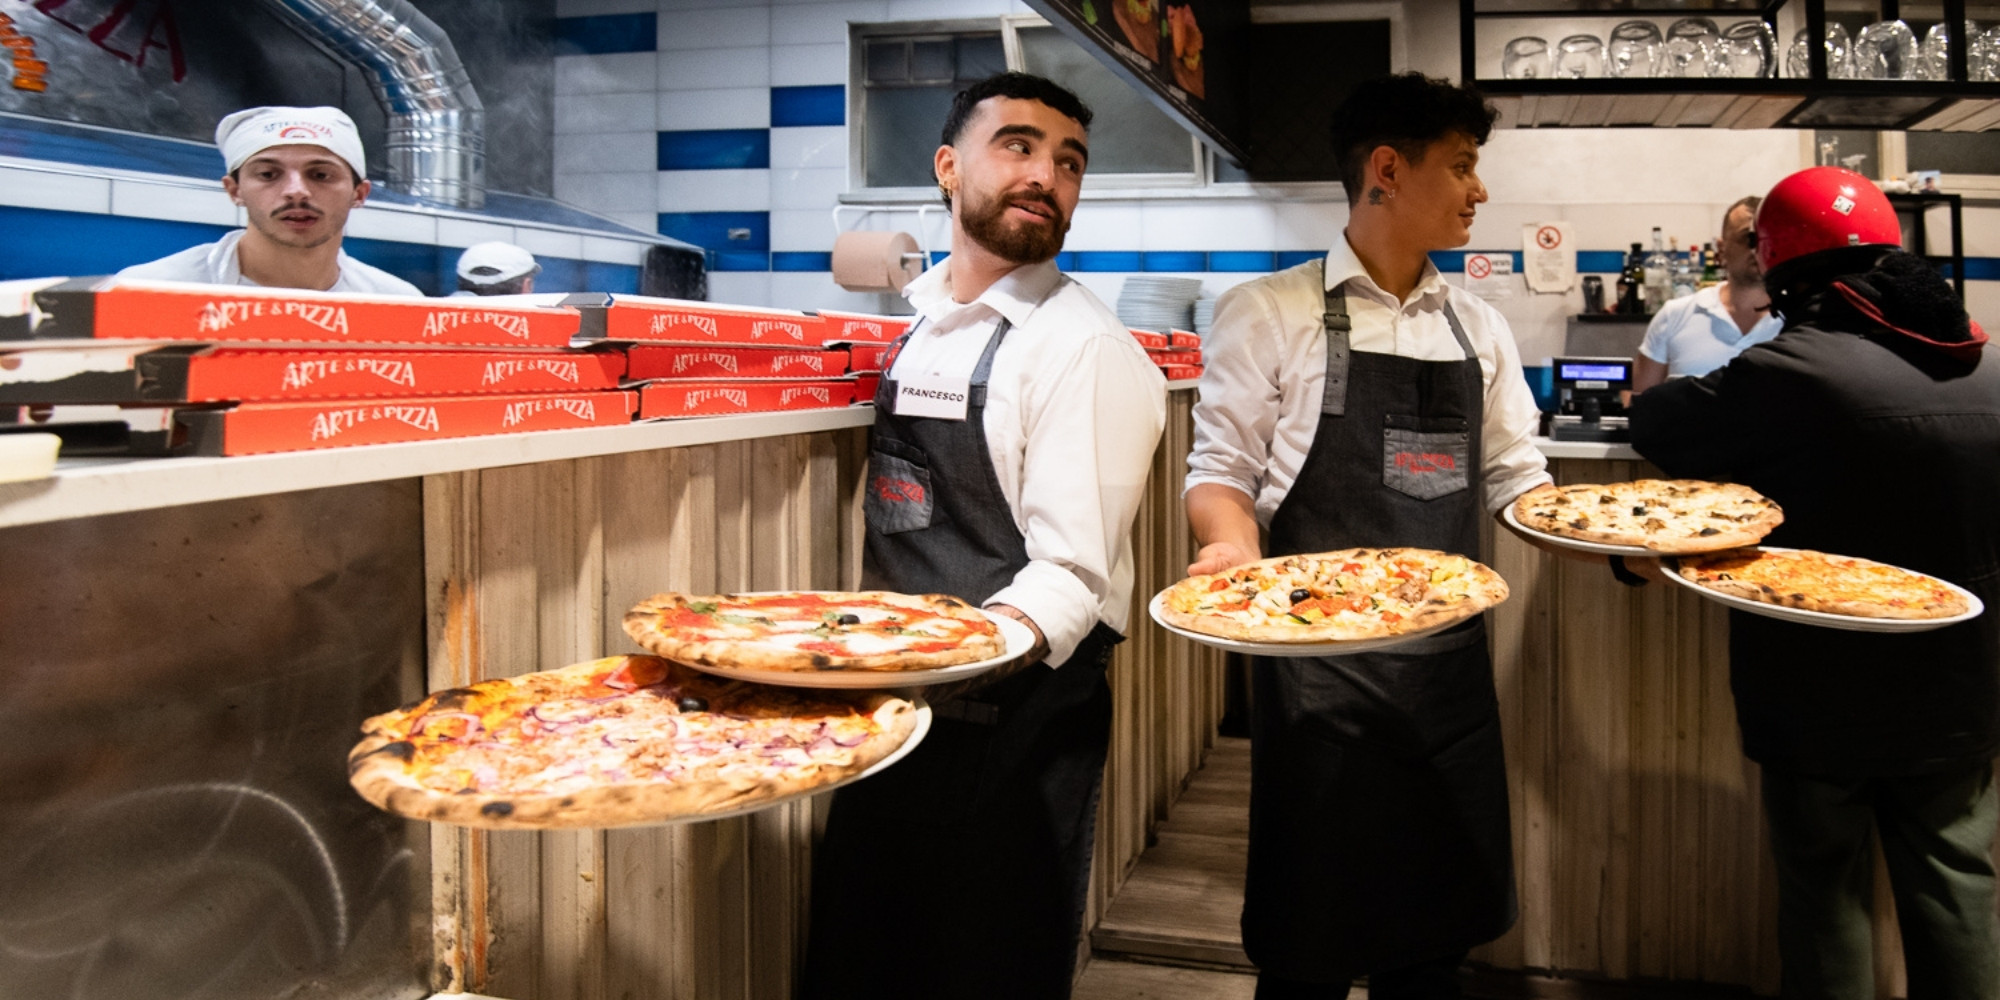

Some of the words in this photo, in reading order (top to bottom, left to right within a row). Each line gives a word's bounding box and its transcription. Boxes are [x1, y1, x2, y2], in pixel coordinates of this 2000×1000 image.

[198, 301, 267, 333] ARTE
[270, 302, 283, 316] &
[285, 302, 349, 335] PIZZA
[422, 311, 472, 338] ARTE
[473, 312, 483, 324] &
[483, 312, 530, 340] PIZZA
[650, 313, 680, 336] ARTE
[688, 314, 719, 338] PIZZA
[751, 320, 774, 340] ARTE
[779, 321, 804, 341] PIZZA
[281, 359, 343, 391] ARTE
[345, 359, 356, 372] &
[357, 359, 416, 388] PIZZA
[481, 359, 525, 386] ARTE
[527, 359, 537, 371] &
[537, 359, 579, 384] PIZZA
[672, 352, 700, 374] ARTE
[708, 352, 739, 374] PIZZA
[771, 355, 794, 374] ARTE
[800, 354, 824, 373] PIZZA
[683, 388, 711, 412] ARTE
[719, 388, 748, 408] PIZZA
[779, 387, 801, 406] ARTE
[808, 386, 830, 405] PIZZA
[902, 386, 965, 402] FRANCESCO
[311, 407, 370, 442] ARTE
[371, 406, 383, 420] &
[384, 406, 440, 433] PIZZA
[502, 400, 544, 428] ARTE
[545, 400, 554, 411] &
[554, 399, 596, 422] PIZZA
